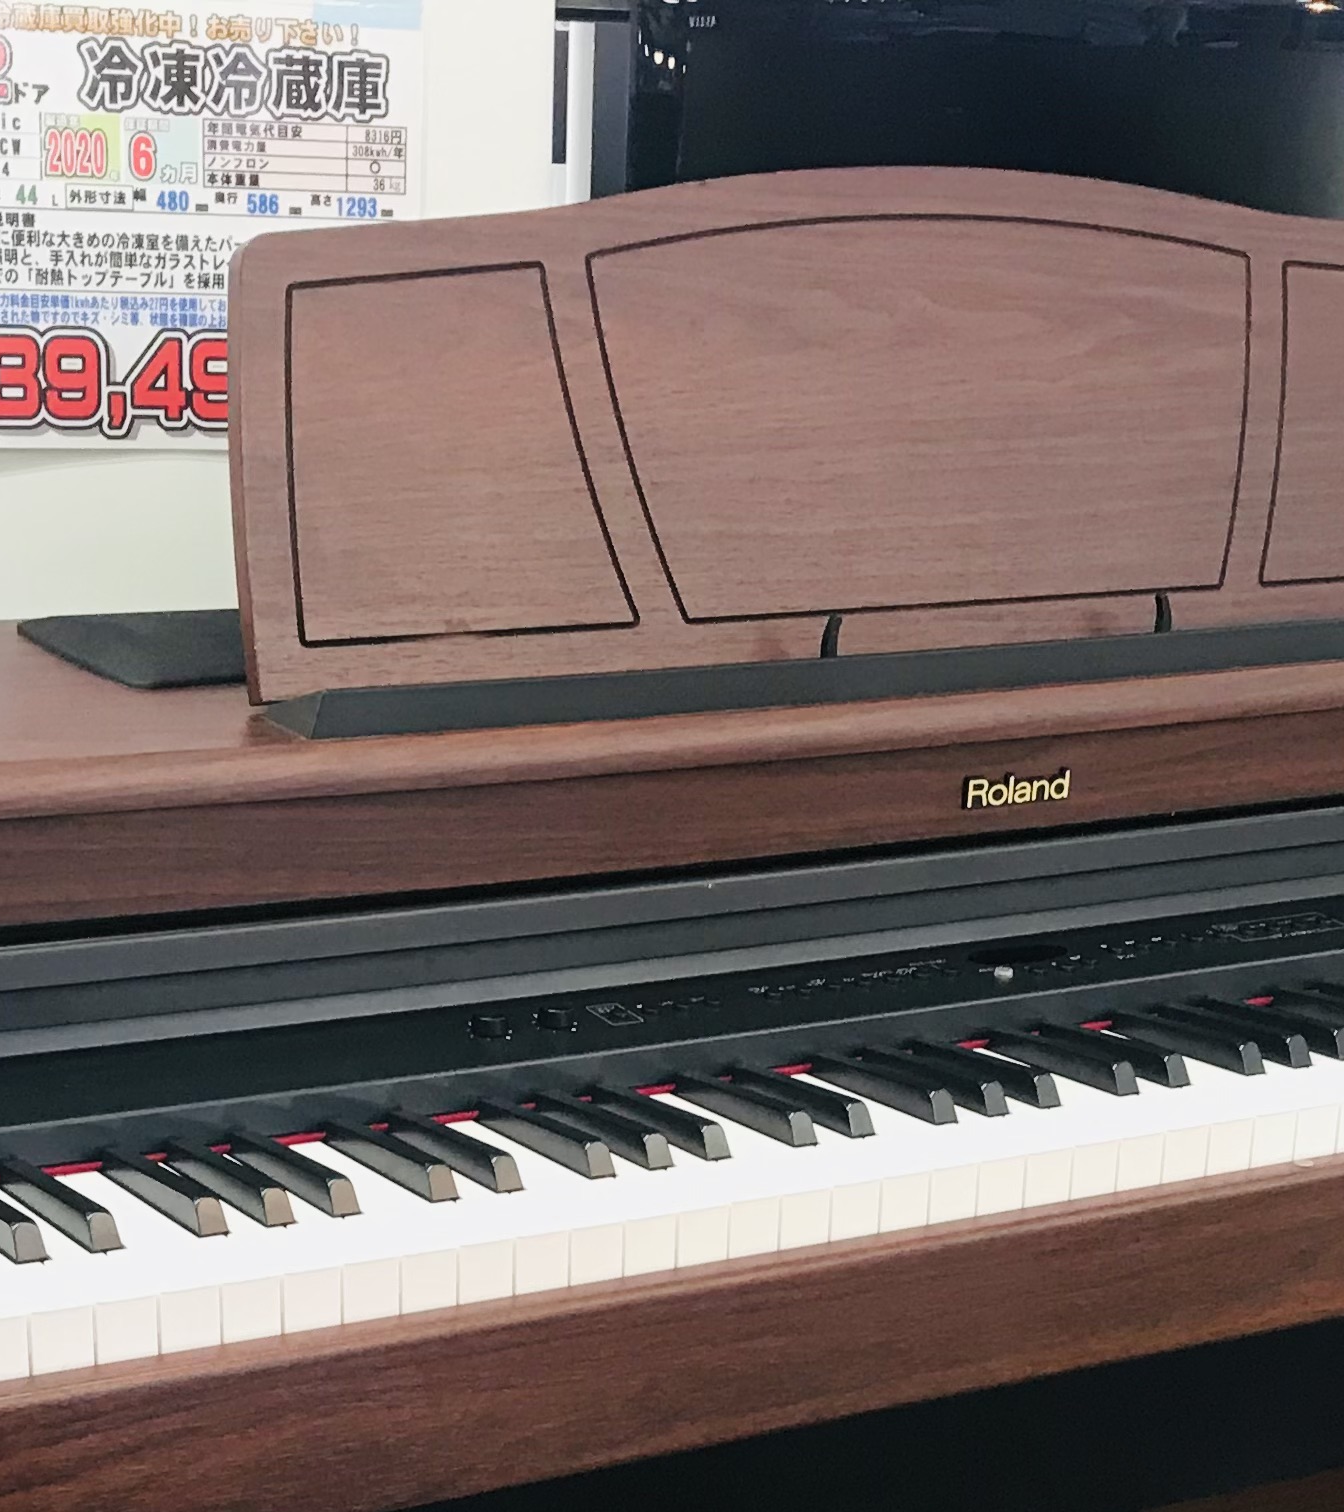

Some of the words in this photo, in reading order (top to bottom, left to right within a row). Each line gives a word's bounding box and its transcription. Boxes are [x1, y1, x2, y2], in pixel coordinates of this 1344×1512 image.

[77, 36, 391, 122] 冷凍冷蔵庫
[44, 126, 109, 180] 2020
[207, 156, 270, 171] ノンフロン
[15, 184, 39, 205] 44
[69, 188, 127, 206] 外形寸法
[156, 190, 190, 212] 480
[247, 193, 280, 215] 586
[336, 196, 378, 218] 1293
[964, 769, 1071, 809] Roland
